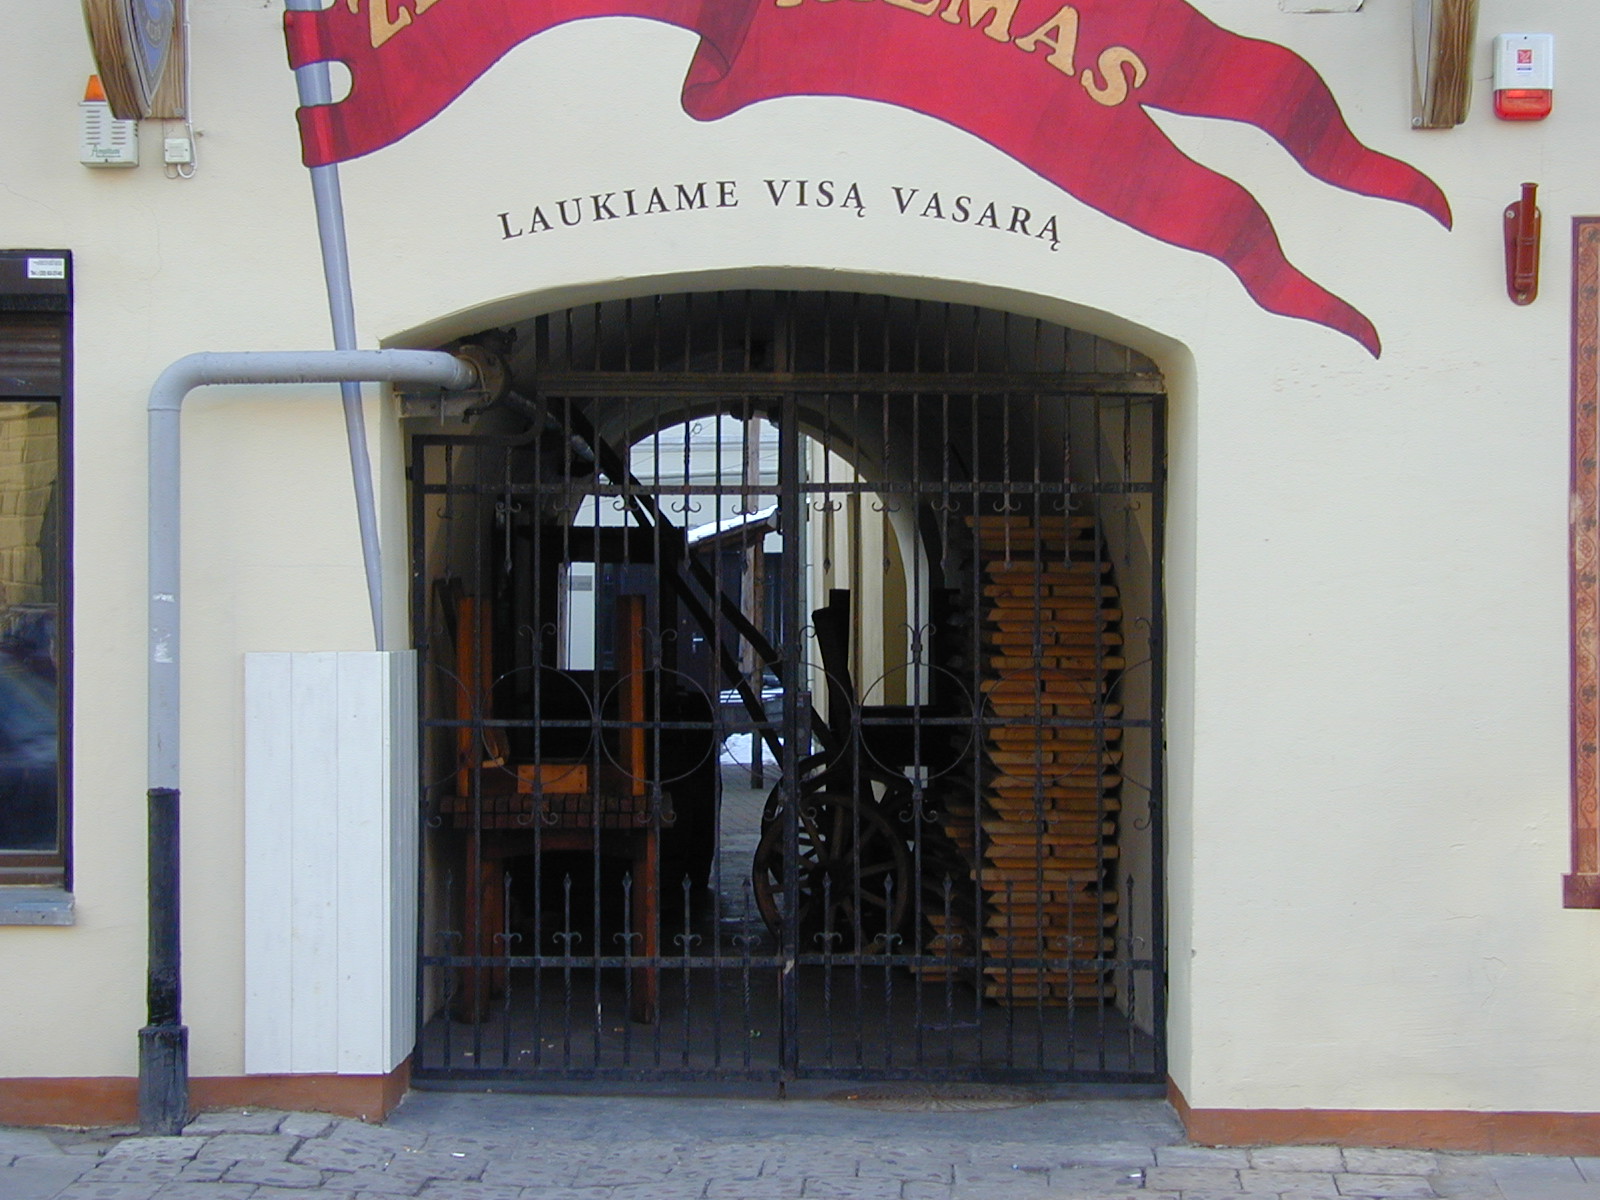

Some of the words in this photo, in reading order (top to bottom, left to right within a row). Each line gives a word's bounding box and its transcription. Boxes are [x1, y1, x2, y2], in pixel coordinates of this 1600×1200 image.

[497, 181, 740, 240] LAUKIAME
[763, 179, 867, 218] VISĄ
[891, 186, 1061, 252] VASARĄ
